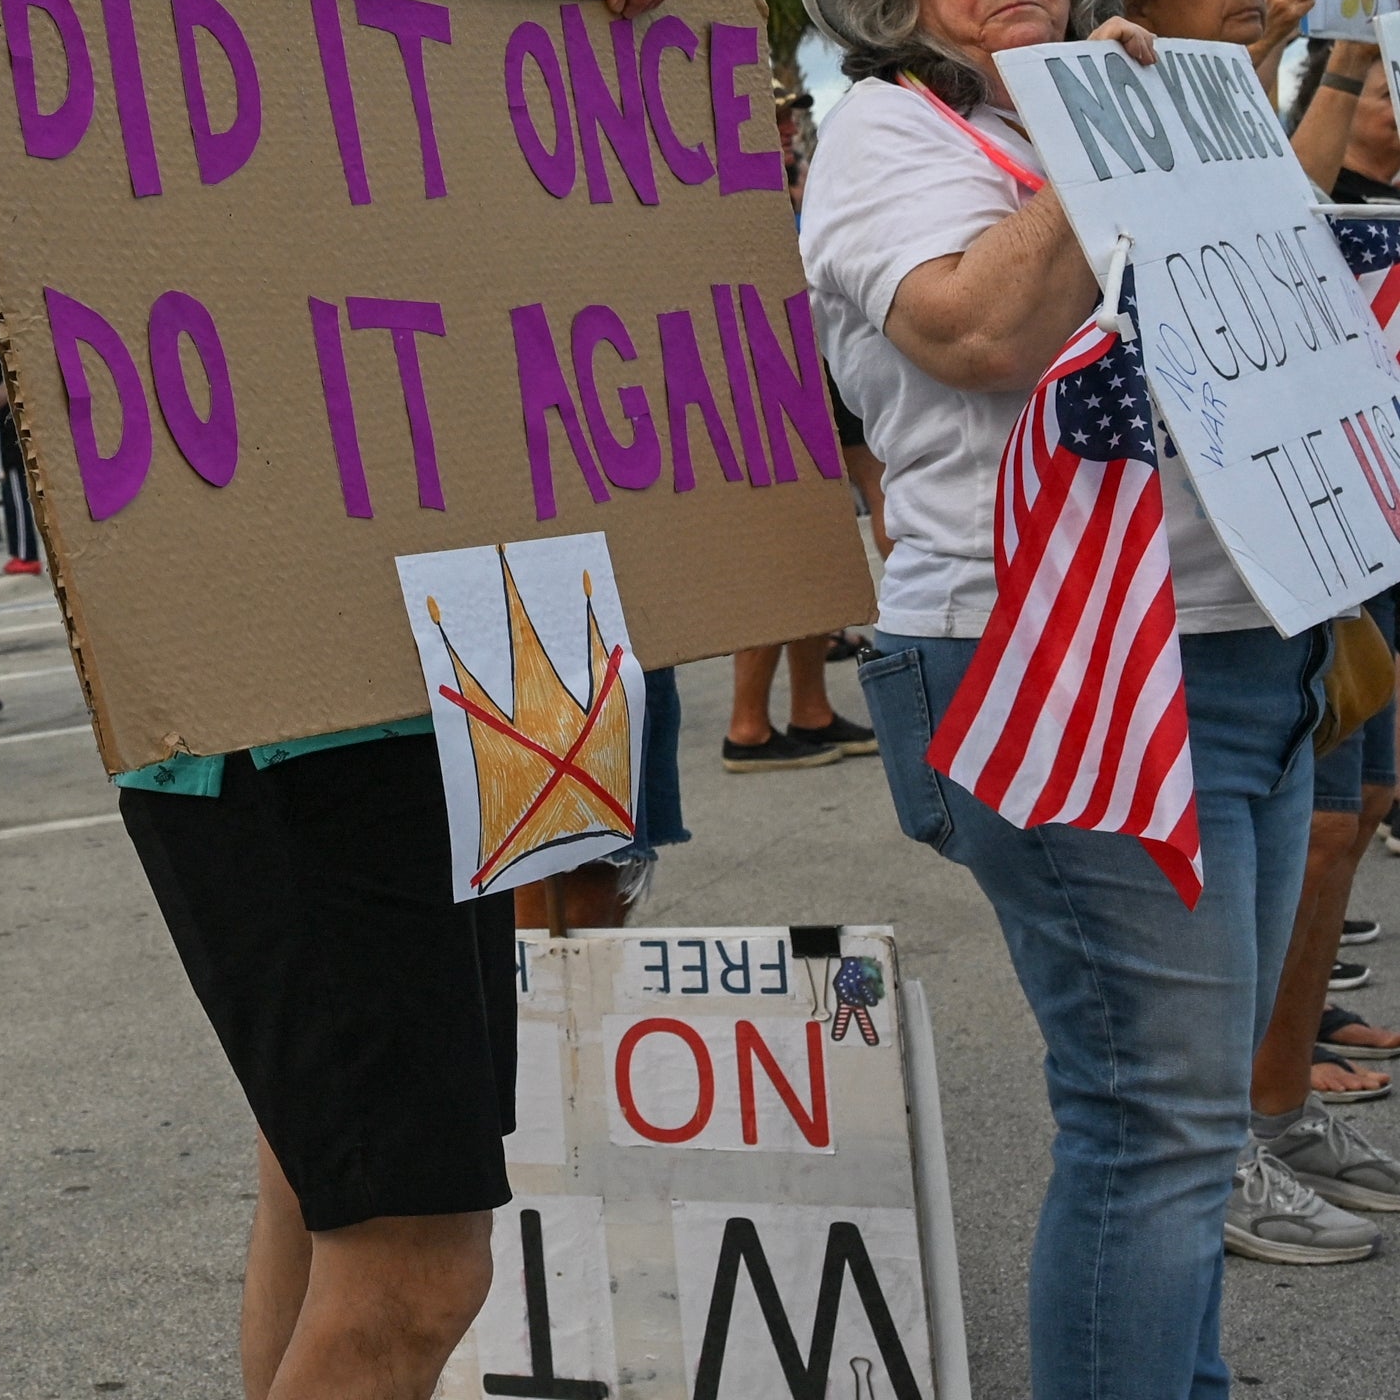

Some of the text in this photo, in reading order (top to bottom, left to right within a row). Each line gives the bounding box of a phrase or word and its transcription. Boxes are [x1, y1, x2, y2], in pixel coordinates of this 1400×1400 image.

[506, 5, 783, 205] ONCE
[1045, 49, 1284, 181] NO KINGS
[1155, 323, 1197, 412] NO
[1166, 240, 1287, 381] GOD
[1256, 225, 1360, 352] SAVE
[45, 285, 841, 520] DO IT AGAIN
[1200, 381, 1227, 468] WAR
[1251, 429, 1384, 597] THE
[640, 940, 789, 995] FREE
[614, 1017, 831, 1148] NO
